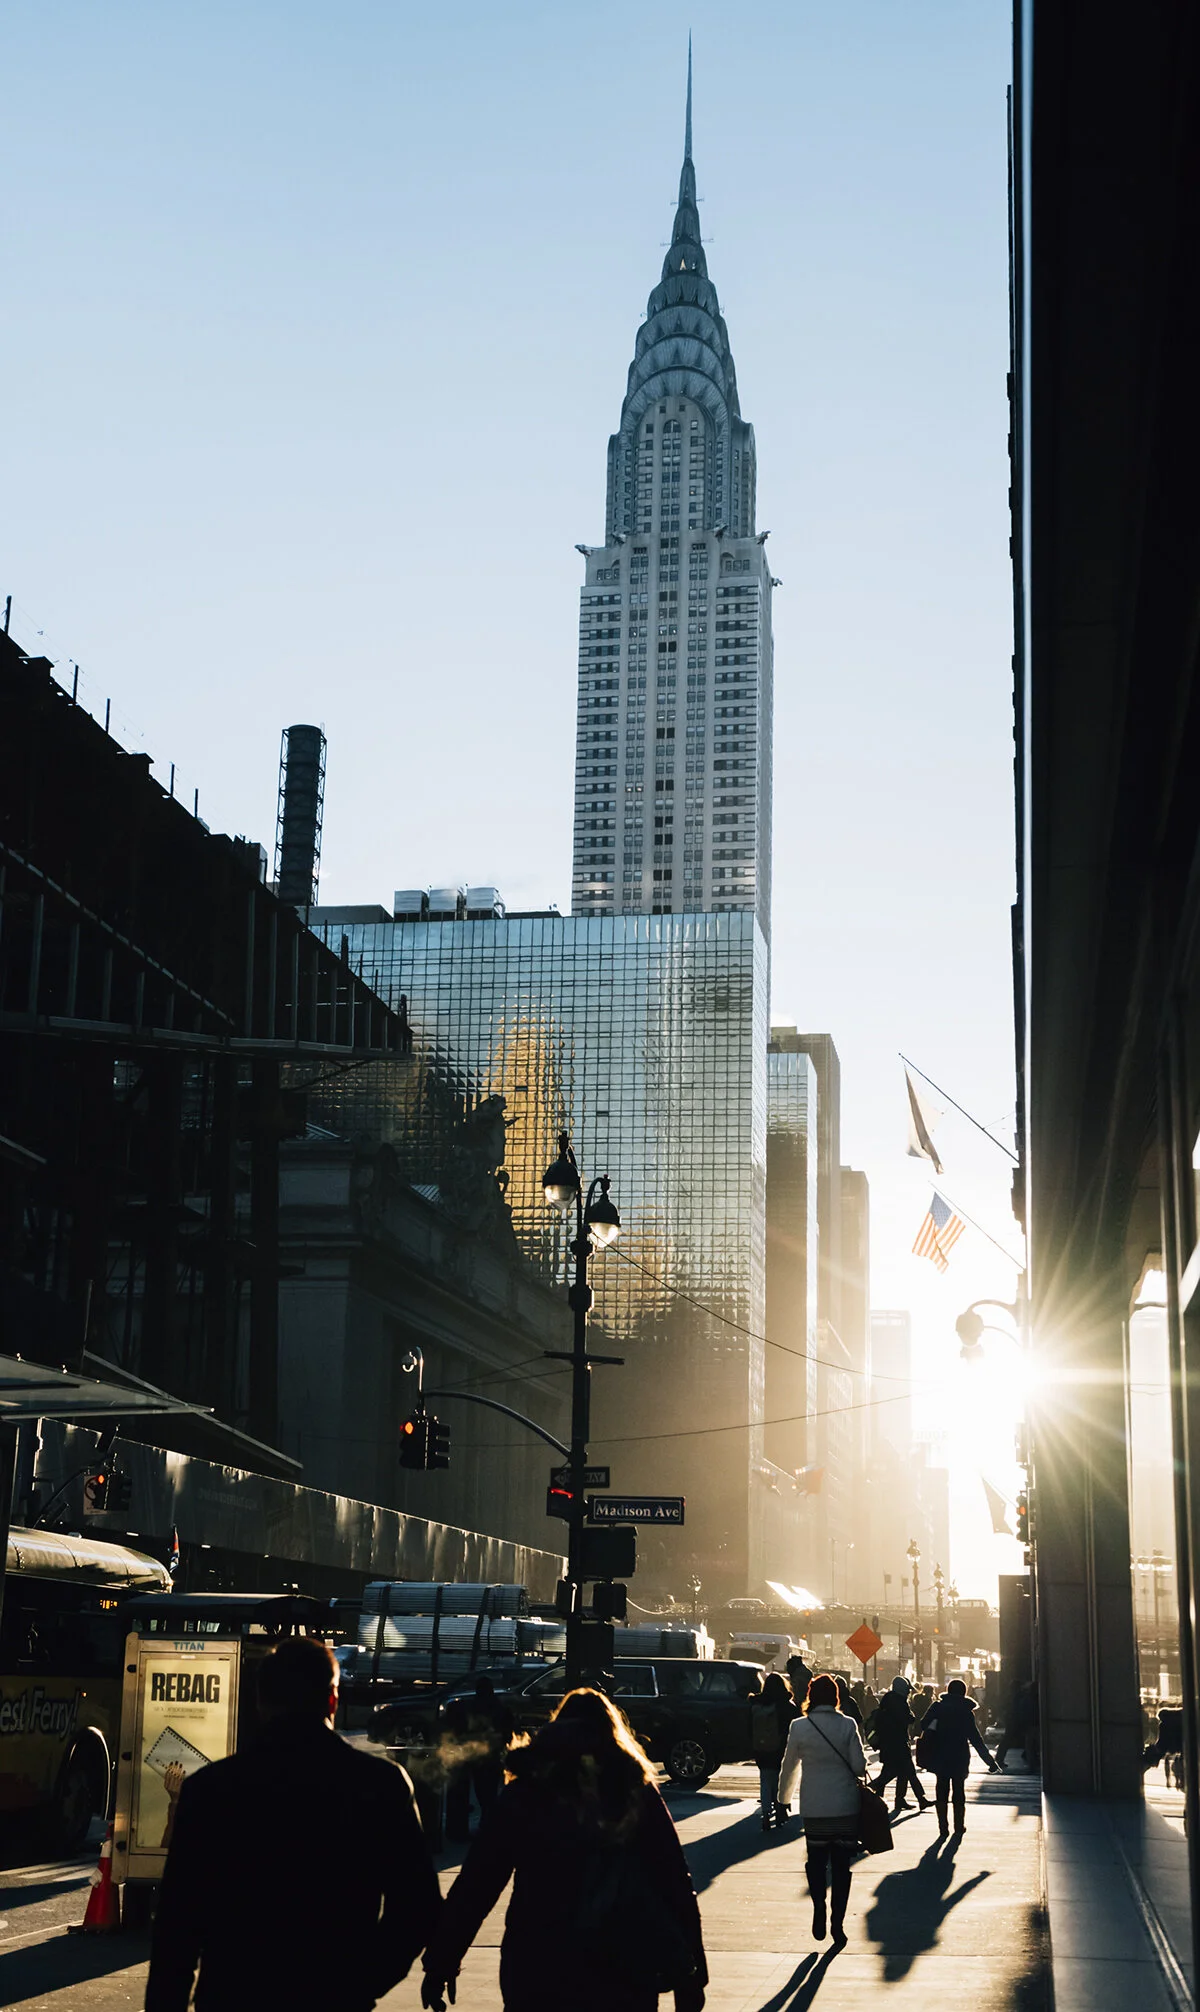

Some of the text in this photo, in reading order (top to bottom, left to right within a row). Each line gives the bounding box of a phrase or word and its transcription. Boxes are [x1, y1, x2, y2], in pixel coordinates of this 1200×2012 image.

[595, 1504, 680, 1518] Madison Ave
[173, 1641, 205, 1651] TITAN
[151, 1672, 220, 1703] REBAG
[0, 1686, 81, 1740] est Ferry!
